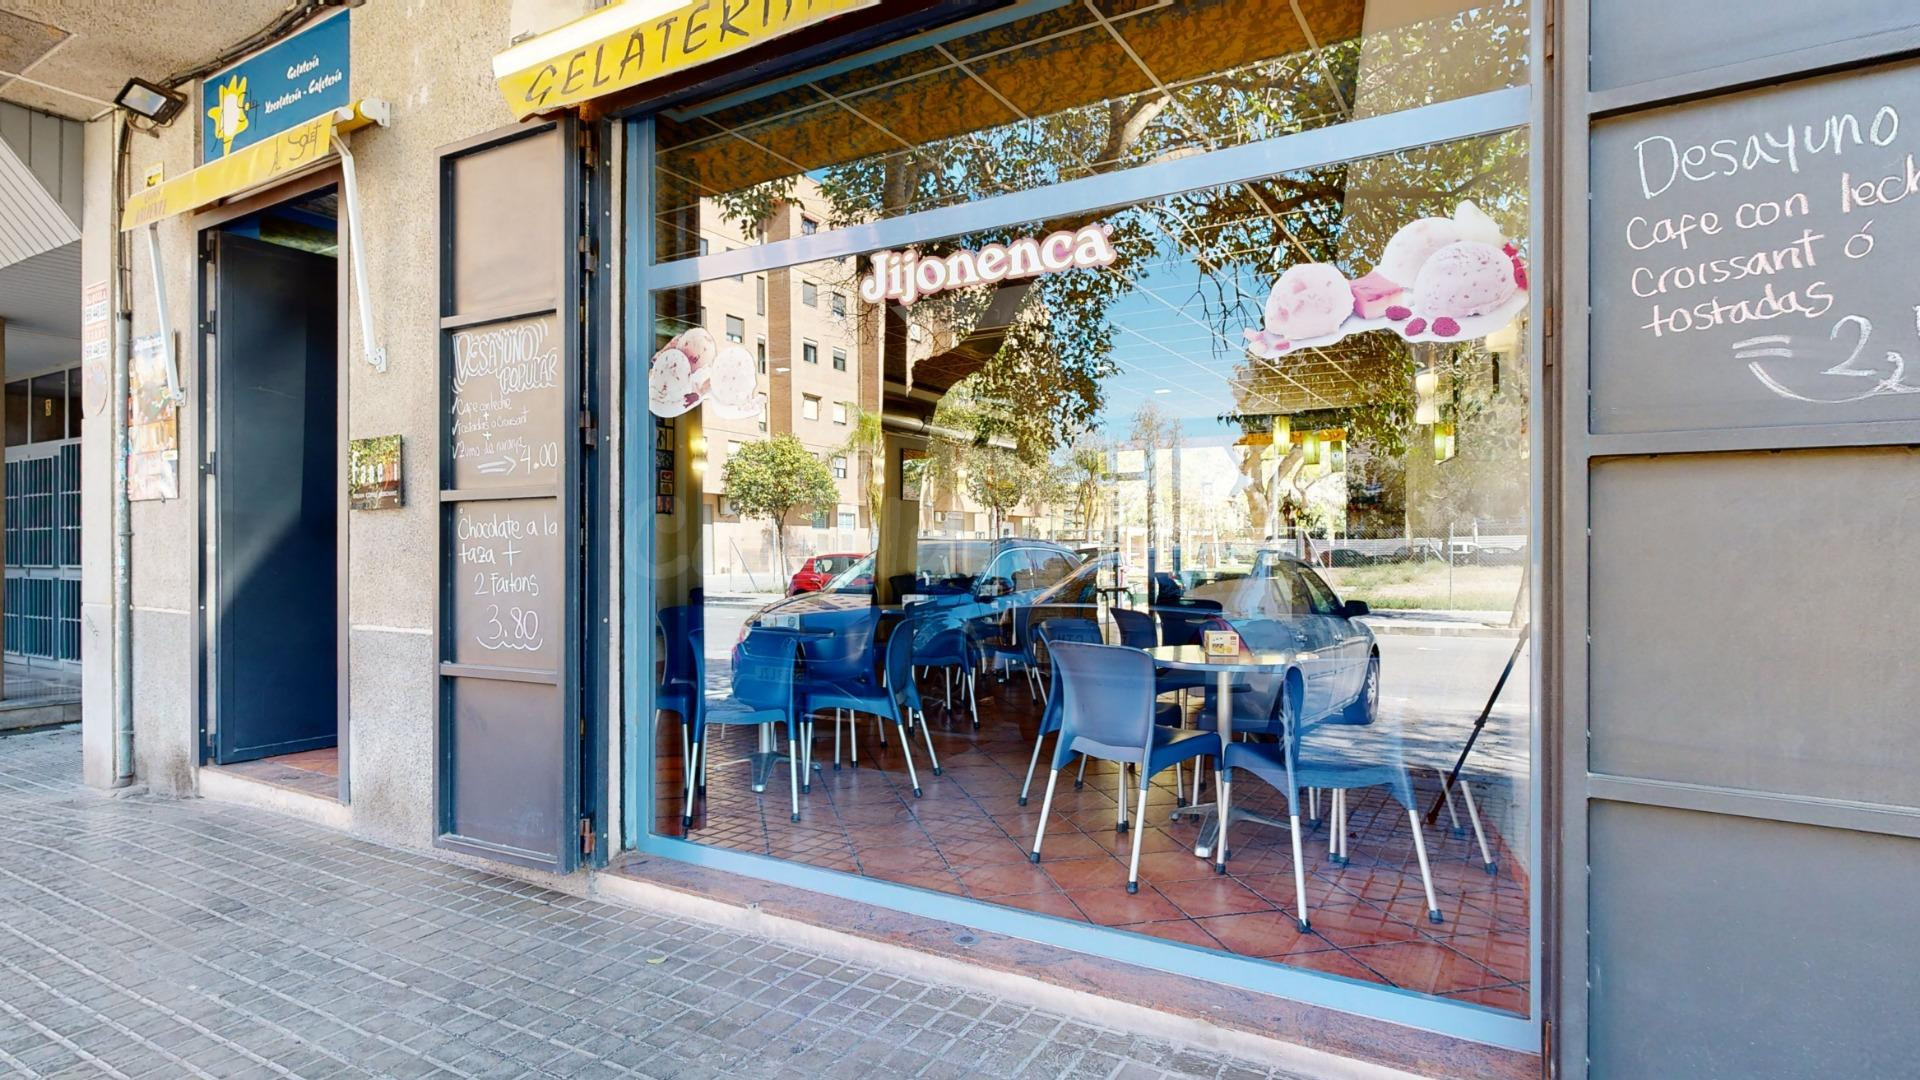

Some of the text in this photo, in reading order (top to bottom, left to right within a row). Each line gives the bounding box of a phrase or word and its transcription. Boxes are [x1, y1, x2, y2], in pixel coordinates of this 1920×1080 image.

[1634, 106, 1899, 200] Desayuno
[1626, 211, 1723, 250] Cafe
[1735, 192, 1809, 229] con
[861, 225, 1117, 305] Jijonenca
[1641, 281, 1834, 338] tostadas
[457, 512, 525, 541] Chocolate
[542, 512, 558, 537] la
[457, 542, 497, 565] taza
[473, 571, 489, 596] 2
